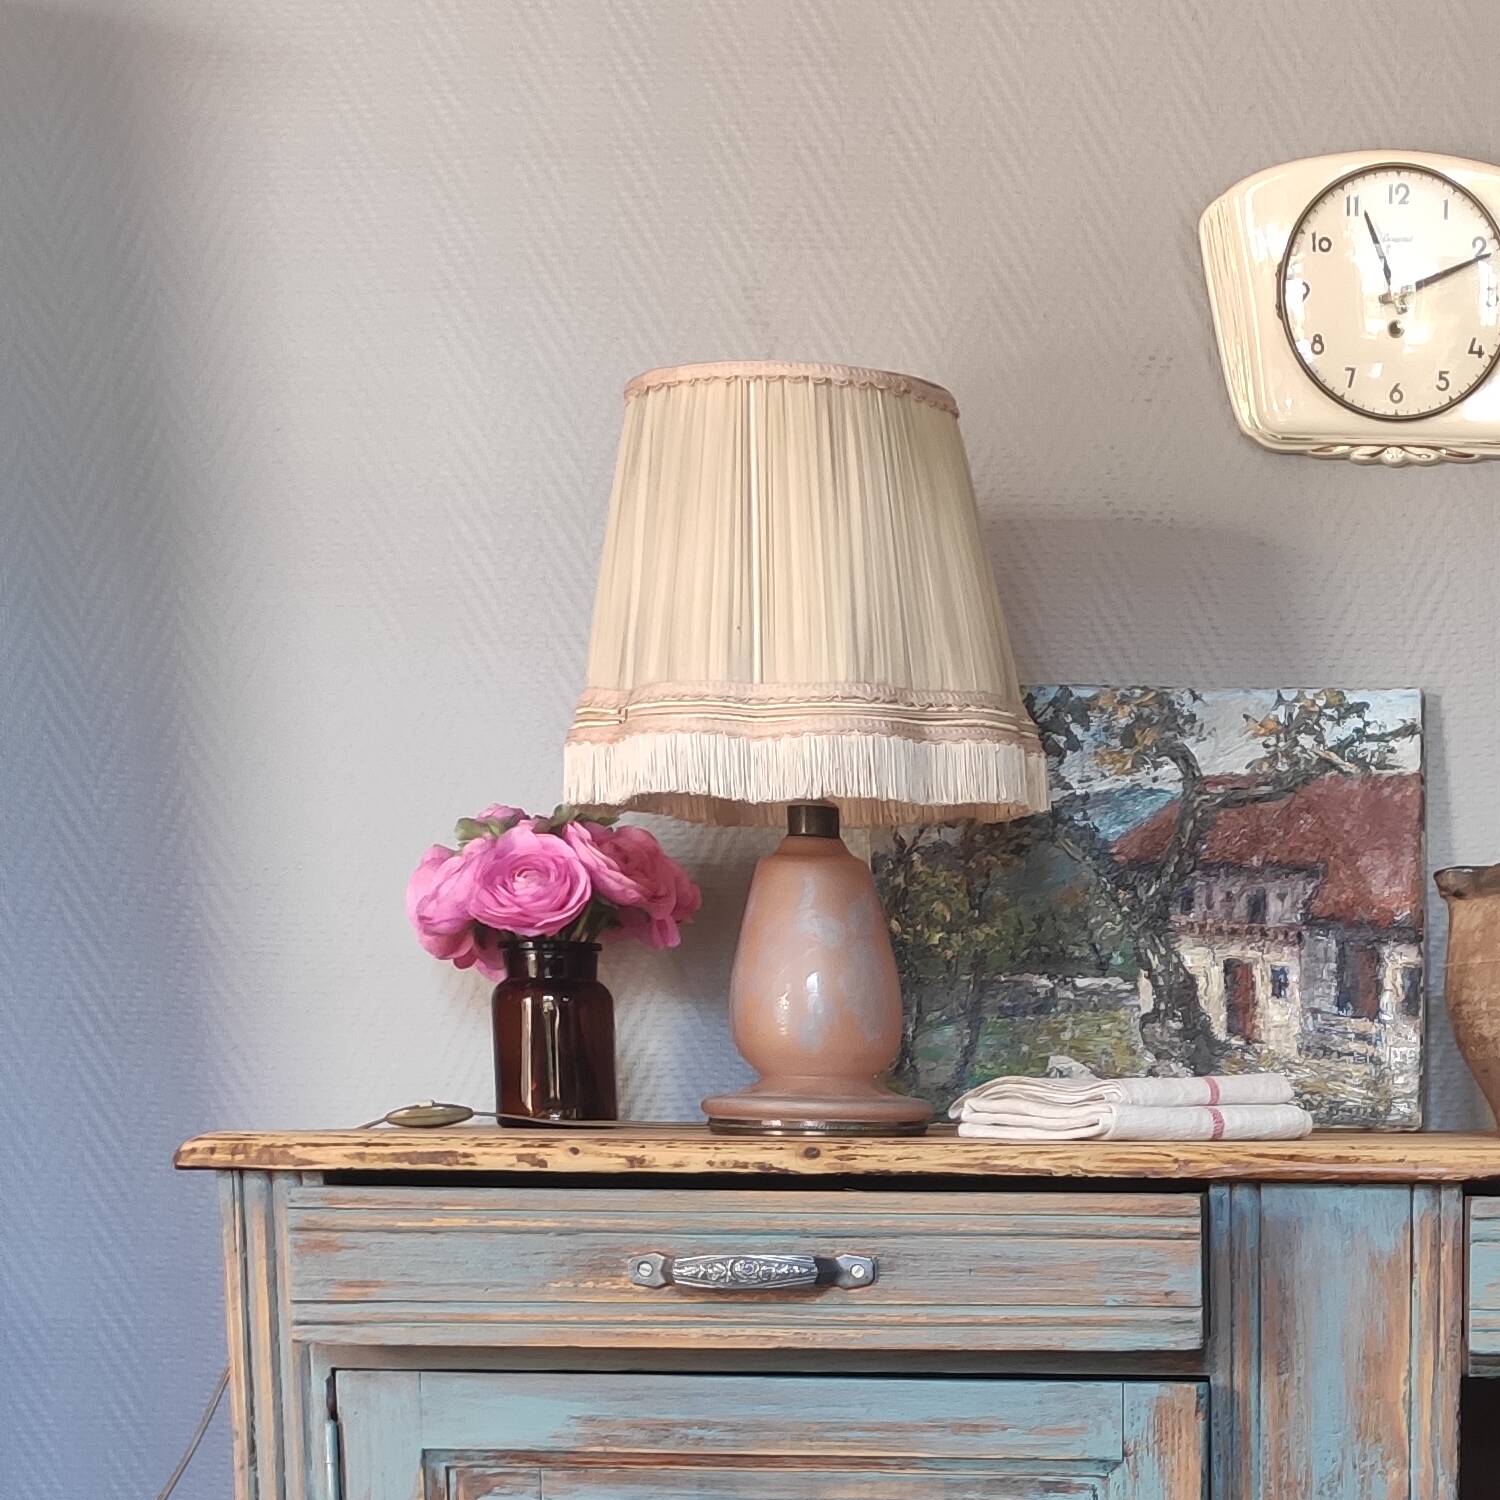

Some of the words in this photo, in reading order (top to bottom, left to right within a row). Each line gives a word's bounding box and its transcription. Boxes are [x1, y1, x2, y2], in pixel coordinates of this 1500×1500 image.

[1388, 183, 1410, 205] 12
[1346, 195, 1359, 217] 11
[1443, 199, 1449, 220] 1
[1311, 232, 1332, 253] 10
[1471, 236, 1488, 260] 2
[1310, 333, 1325, 355] 8
[1468, 337, 1485, 359] 4
[1344, 367, 1356, 388] 7
[1435, 370, 1450, 392] 5
[1389, 382, 1404, 404] 6
